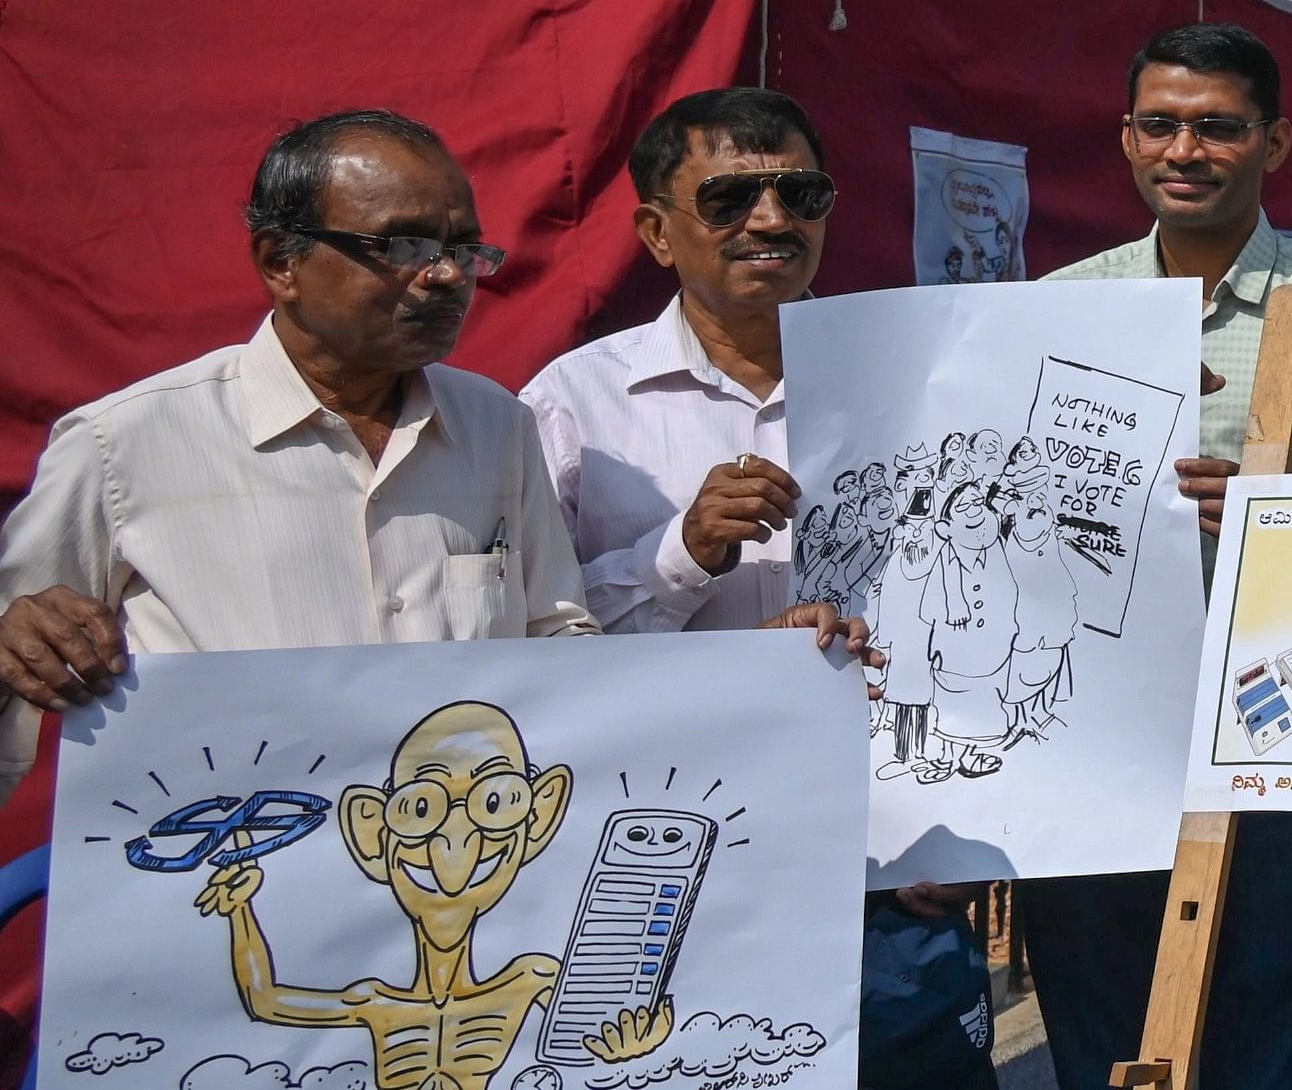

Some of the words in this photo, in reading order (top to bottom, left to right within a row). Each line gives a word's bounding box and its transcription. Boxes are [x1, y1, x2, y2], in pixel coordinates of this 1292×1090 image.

[1052, 393, 1137, 431] NOTHING
[1054, 413, 1108, 438] LIKE
[1055, 474, 1068, 489] I
[1075, 479, 1127, 507] VOTE
[1060, 494, 1097, 516] FOR
[1076, 535, 1127, 558] SURE
[1231, 773, 1267, 797] ನಿಮ್ಮ
[976, 993, 988, 1048] adidas
